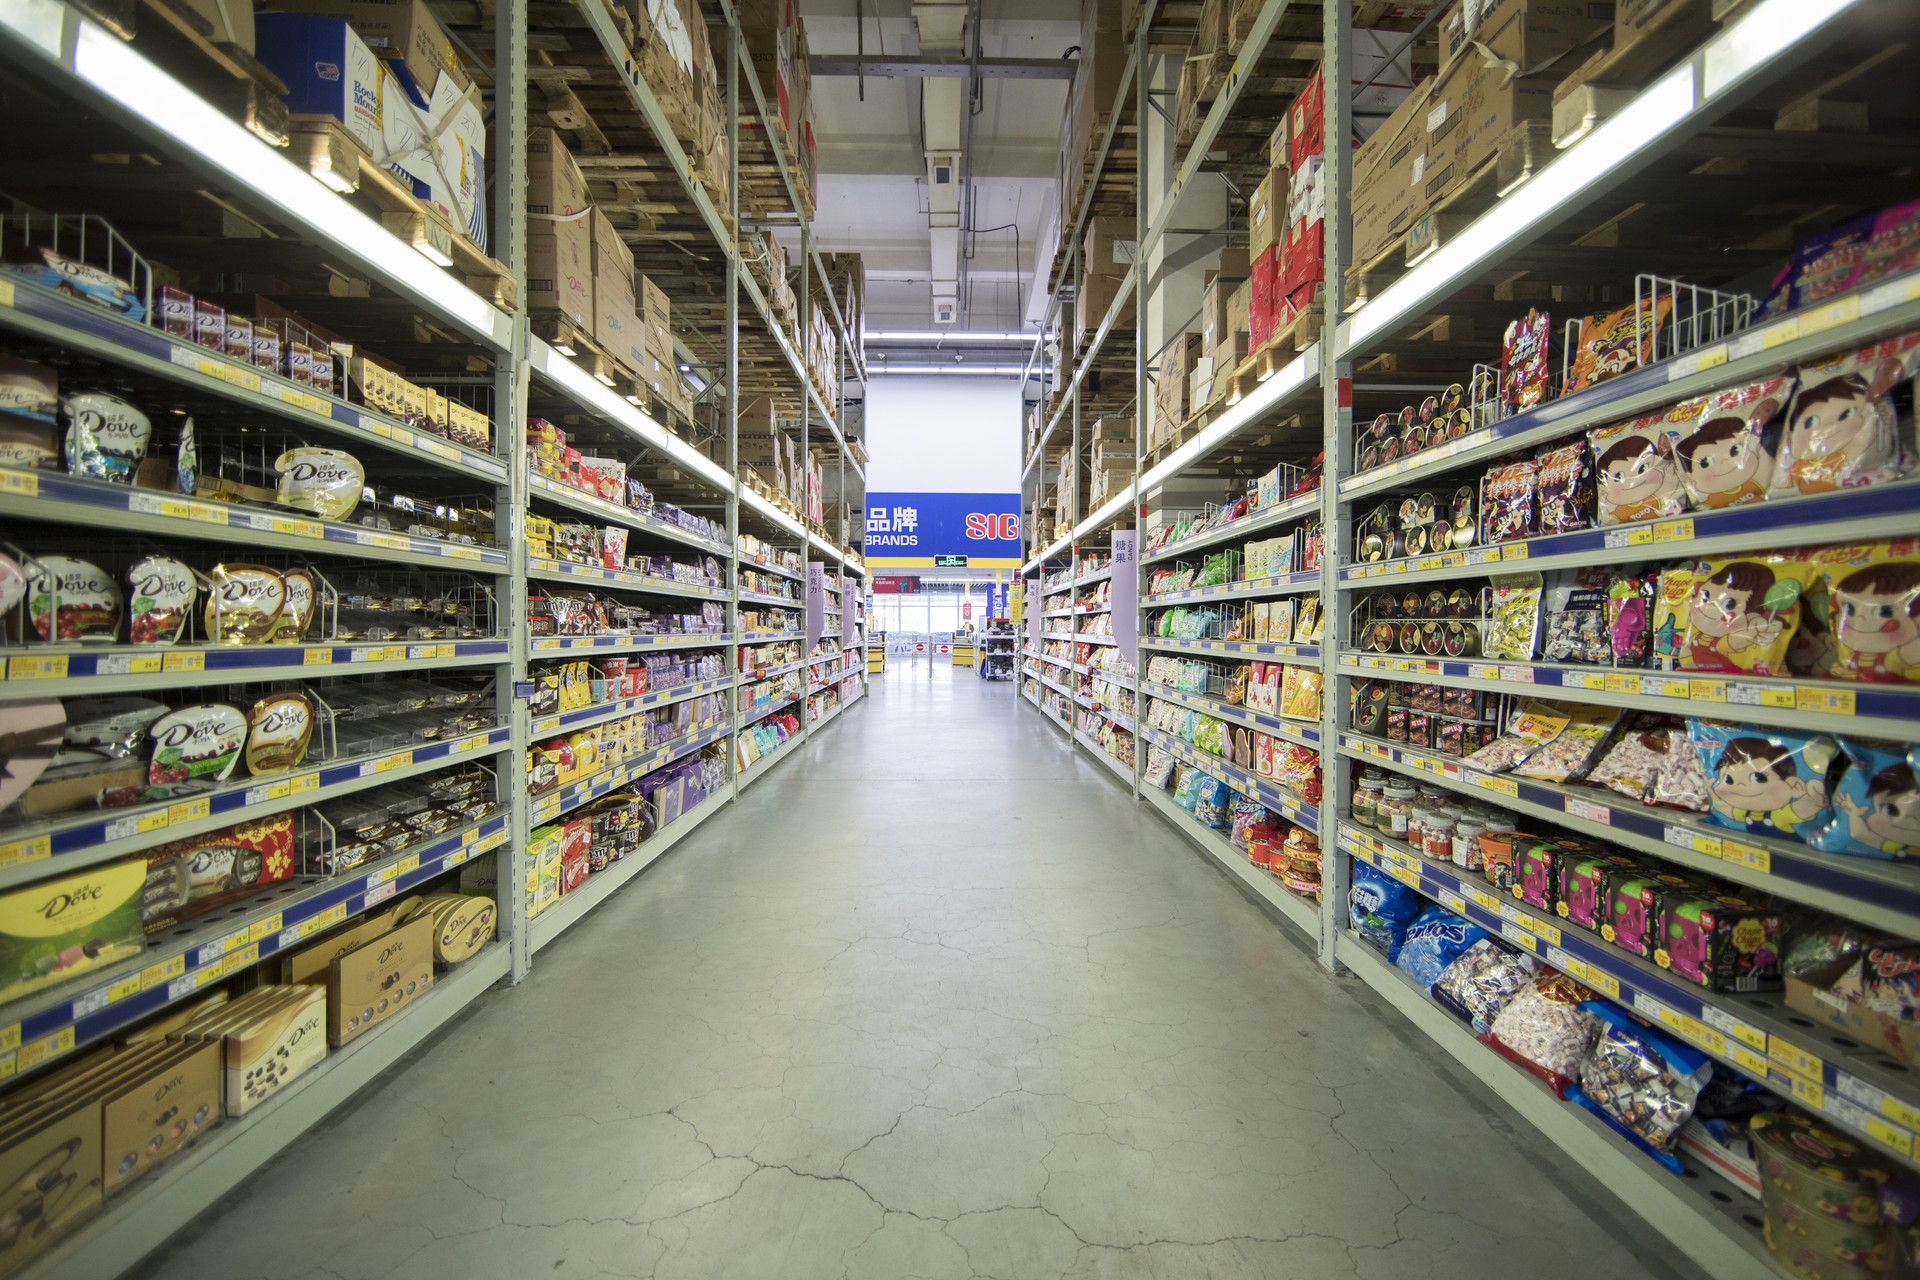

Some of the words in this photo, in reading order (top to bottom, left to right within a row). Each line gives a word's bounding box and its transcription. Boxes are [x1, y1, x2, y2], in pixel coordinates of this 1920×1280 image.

[353, 79, 382, 104] Rock
[353, 91, 382, 119] Moun
[79, 410, 151, 438] Dove
[291, 462, 358, 482] Dove
[865, 507, 918, 533] 品牌
[965, 512, 1021, 540] SIG
[865, 535, 918, 546] BRANDS
[1115, 540, 1126, 564] 糖果
[222, 580, 284, 601] Dove
[810, 568, 818, 594] 巧克力
[36, 886, 103, 919] Dove
[1405, 921, 1467, 944] entos
